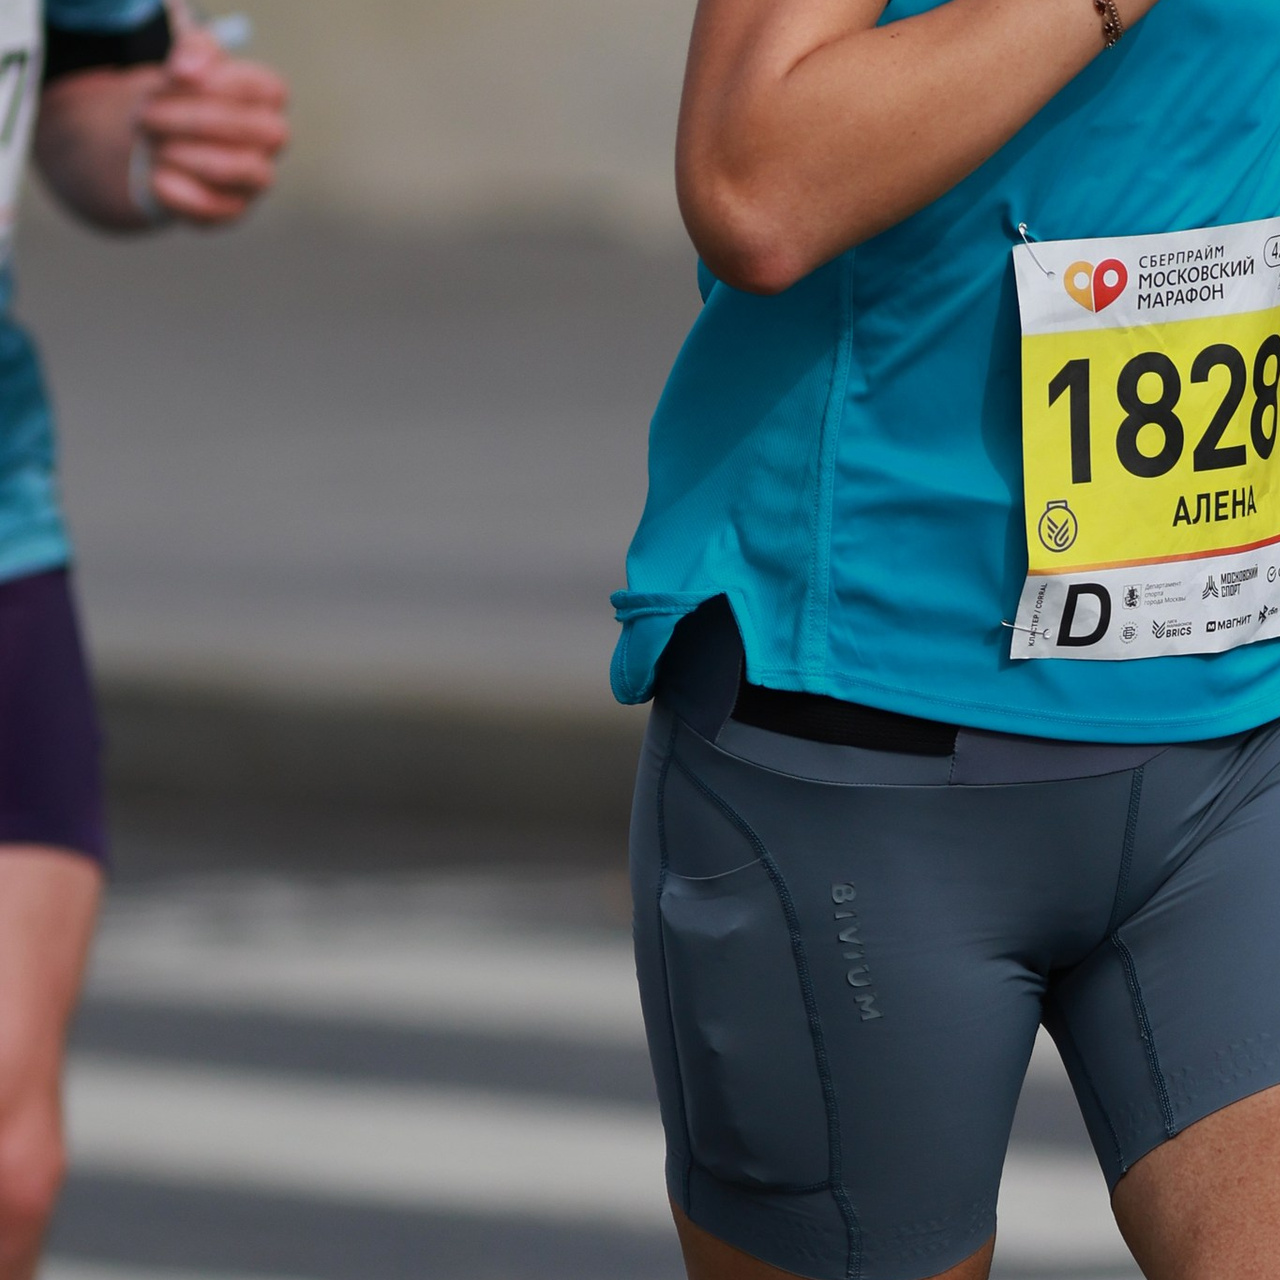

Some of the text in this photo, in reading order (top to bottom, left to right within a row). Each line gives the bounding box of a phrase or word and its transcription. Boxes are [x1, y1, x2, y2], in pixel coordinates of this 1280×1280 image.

[1139, 245, 1224, 268] СБЕРПРАЙМ
[1138, 256, 1255, 290] МОСКОВСКИЙ
[1137, 283, 1224, 310] МАРАФОН
[1172, 485, 1257, 527] АЛЕНА
[1221, 564, 1258, 584] МОСКОВСКИЙ
[1035, 583, 1048, 609] CORRAL
[1221, 583, 1241, 597] СПОРТ
[1056, 583, 1111, 646] D
[1166, 627, 1192, 638] BRICS
[831, 882, 883, 1022] BIVIUM
